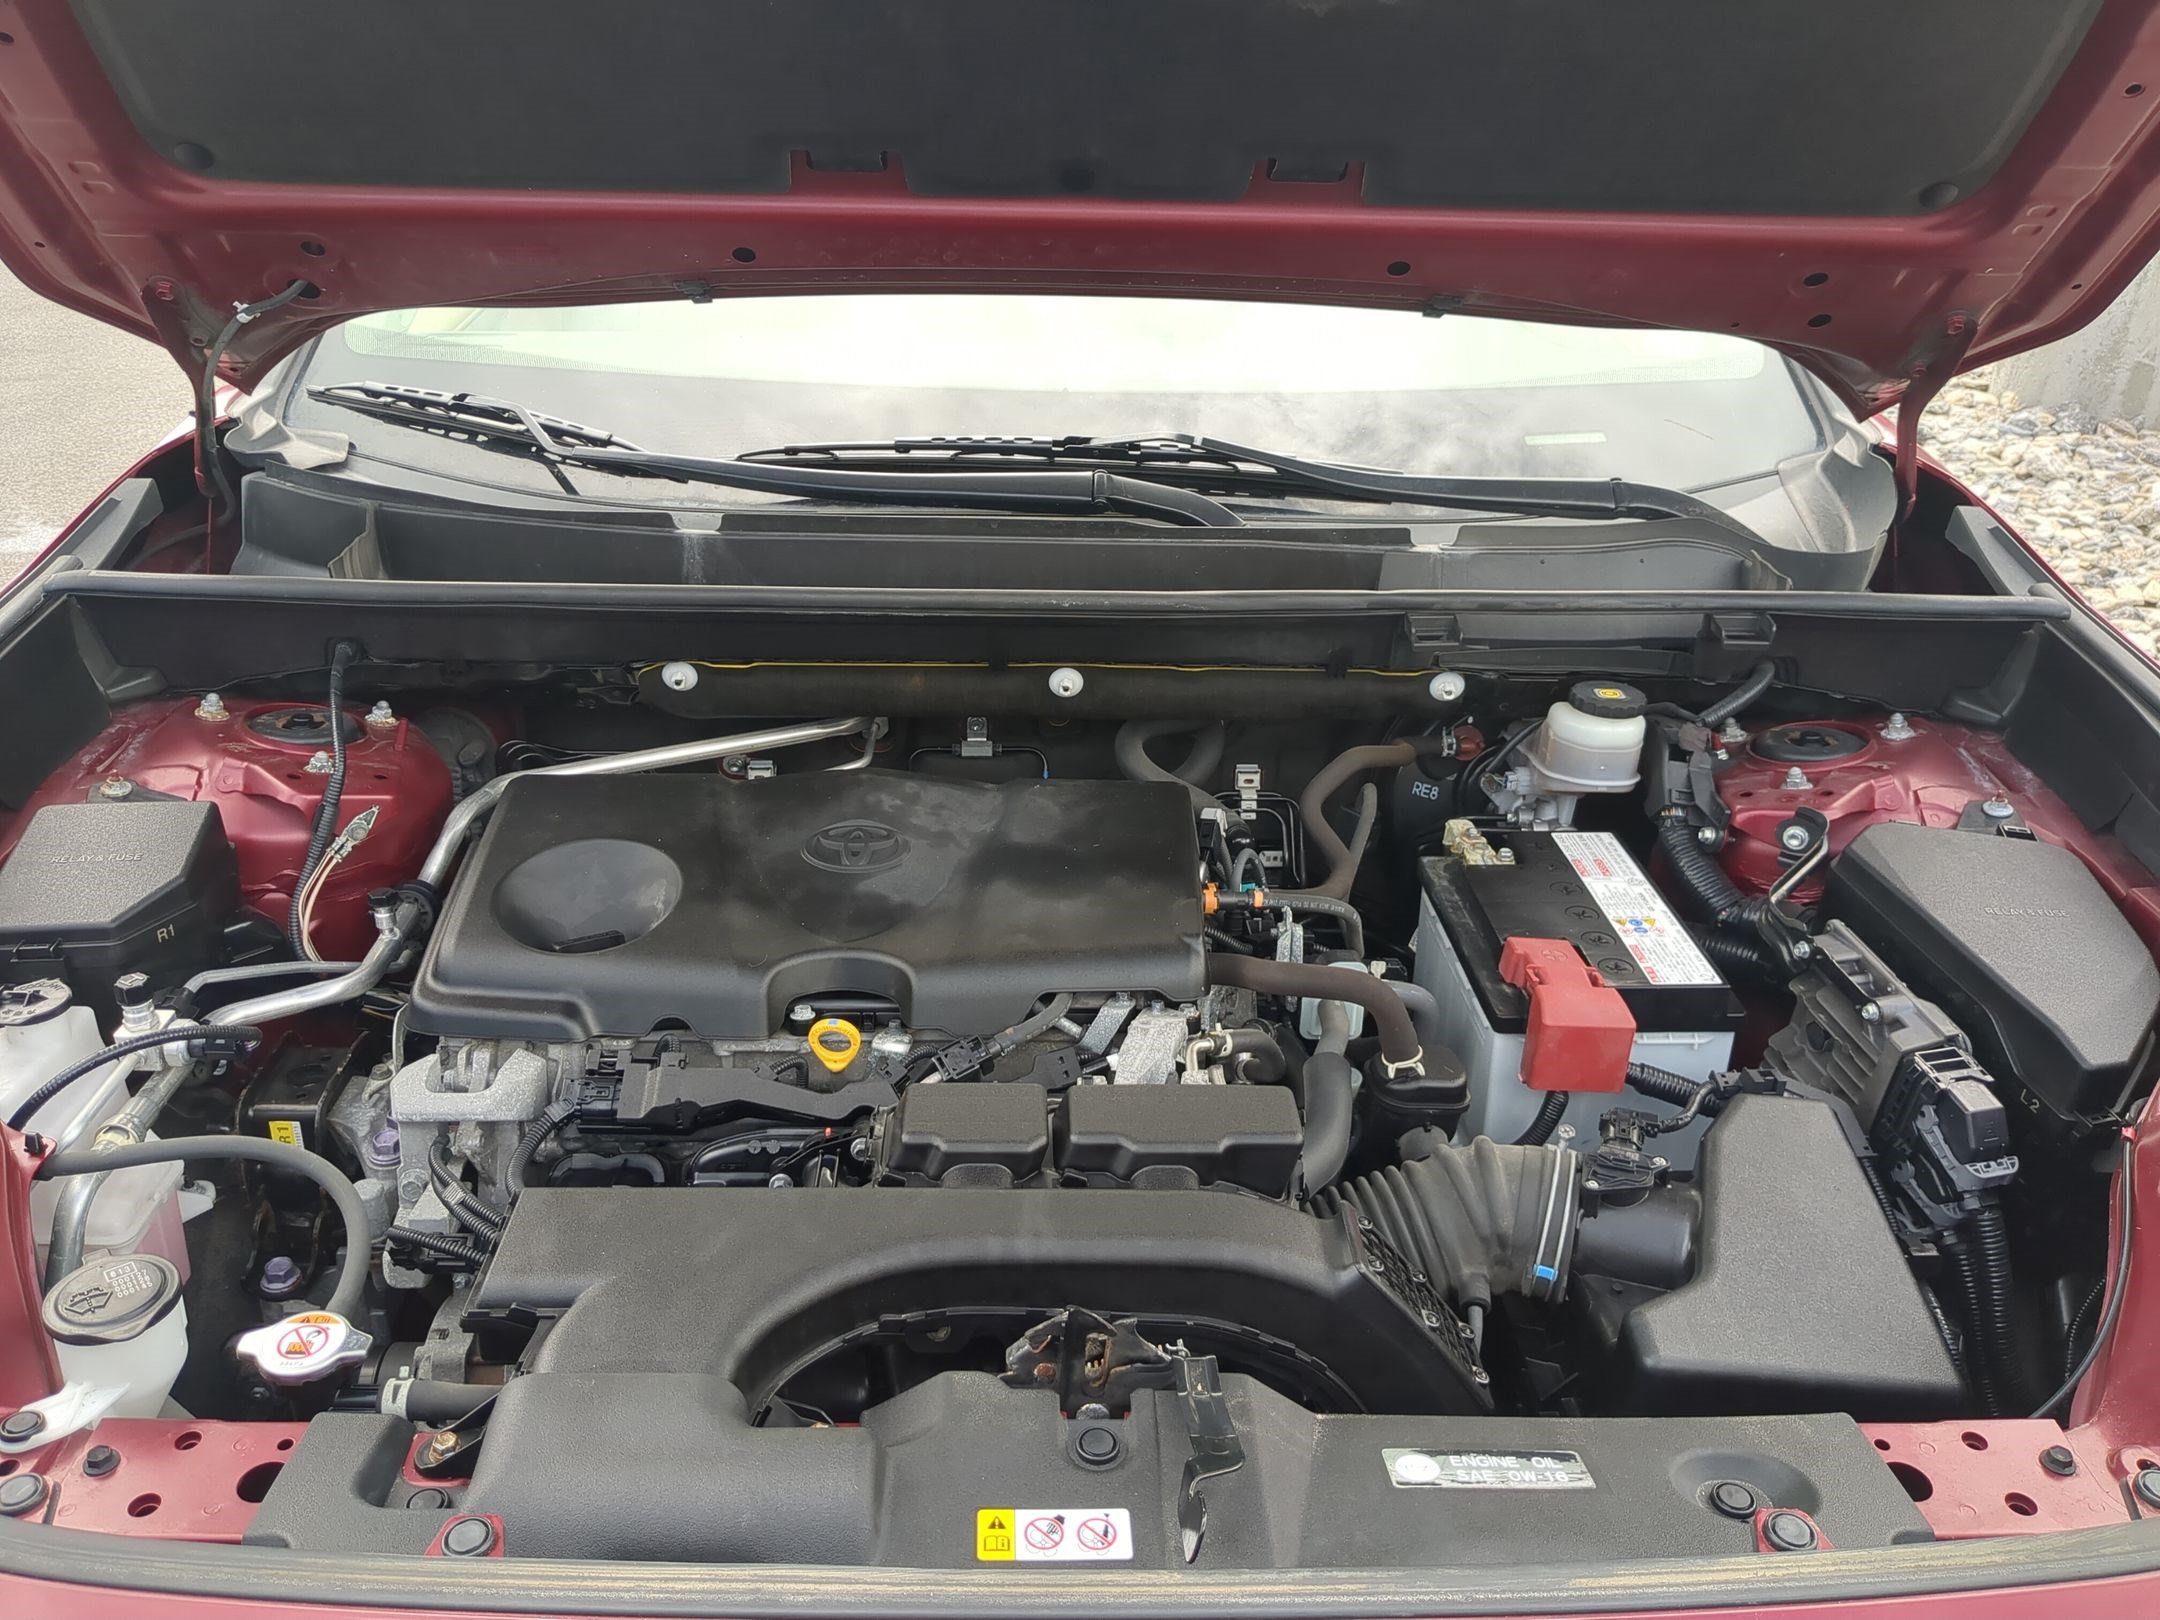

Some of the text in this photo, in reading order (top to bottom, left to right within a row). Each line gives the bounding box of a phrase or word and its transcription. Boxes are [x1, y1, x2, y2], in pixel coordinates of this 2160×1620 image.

[1412, 781, 1439, 800] RE8
[50, 855, 95, 864] RELAY
[107, 853, 144, 862] FUSE
[156, 923, 175, 943] R1
[276, 1127, 292, 1145] R1
[1449, 1455, 1564, 1469] ENGINE OIL
[1456, 1469, 1569, 1483] SAE 0W-16
